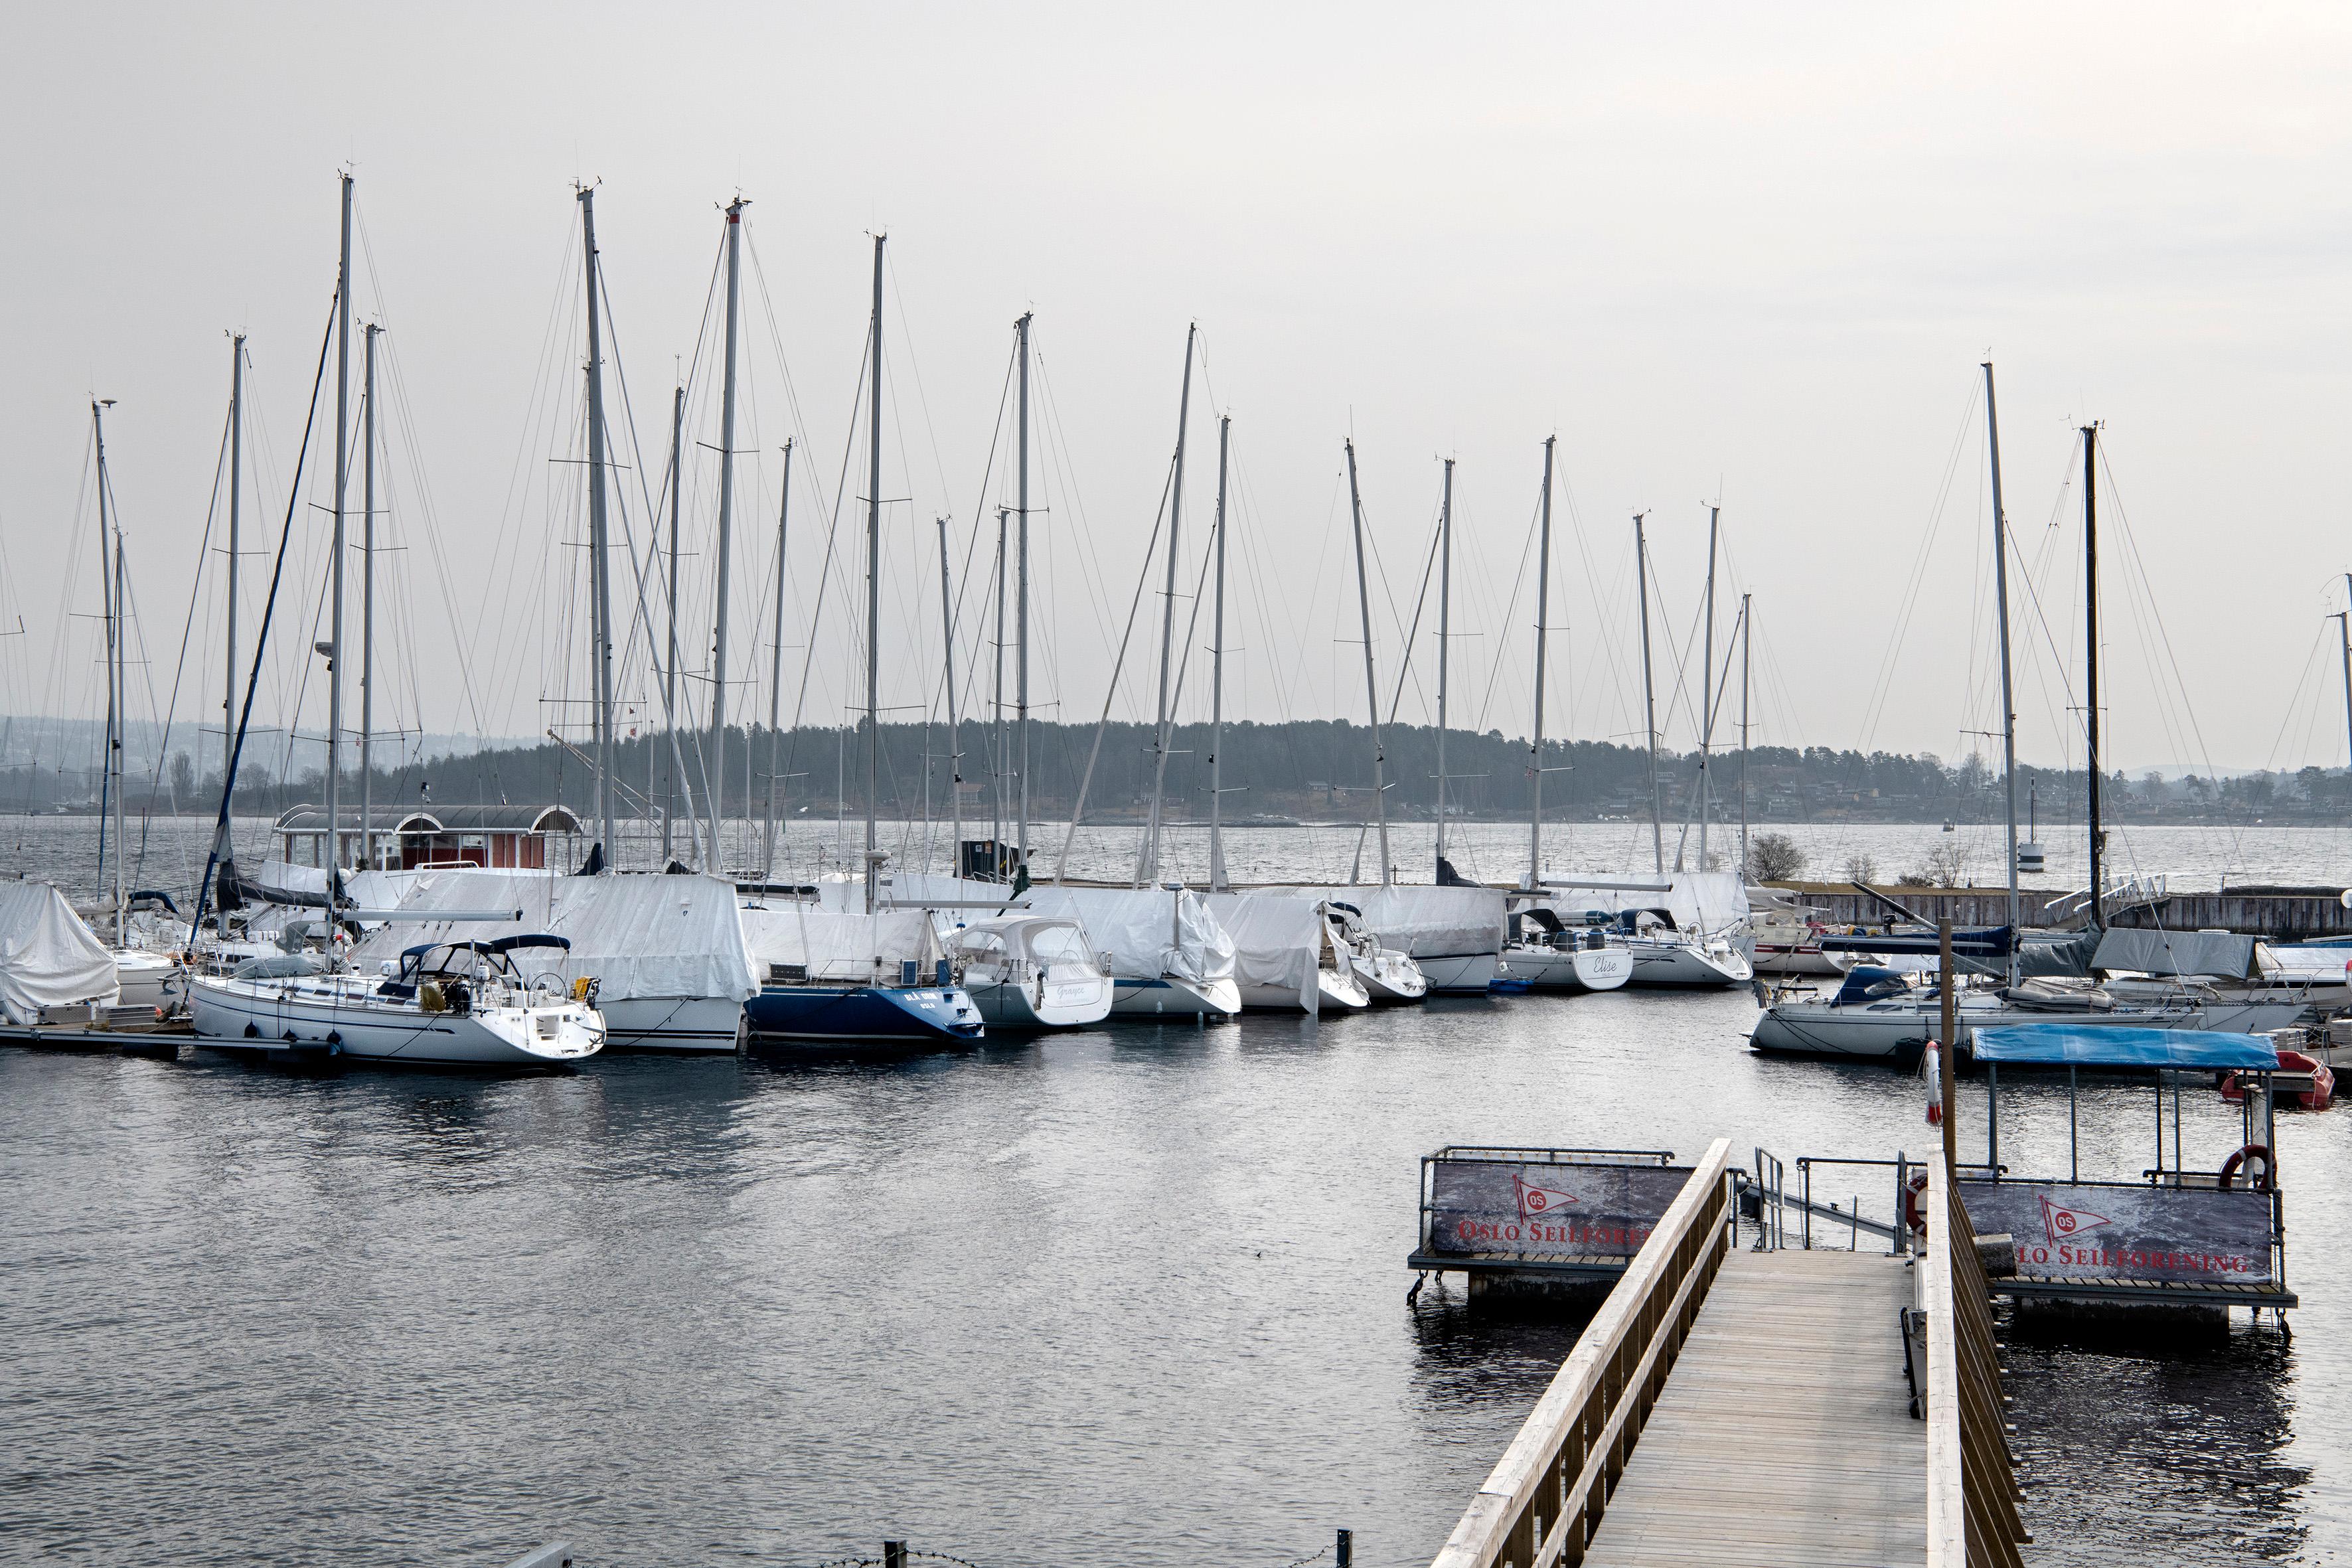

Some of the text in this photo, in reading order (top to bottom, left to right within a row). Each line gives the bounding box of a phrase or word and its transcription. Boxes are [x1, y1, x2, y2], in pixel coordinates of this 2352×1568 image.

[1593, 957, 1617, 973] Elise
[903, 991, 921, 1001] BLÅ
[1057, 986, 1085, 998] Grayce
[1529, 1196, 1544, 1206] OS
[2058, 1216, 2074, 1227] OS
[1458, 1220, 1520, 1241] OSLO
[2018, 1245, 2249, 1273] LO SEILFORENING
